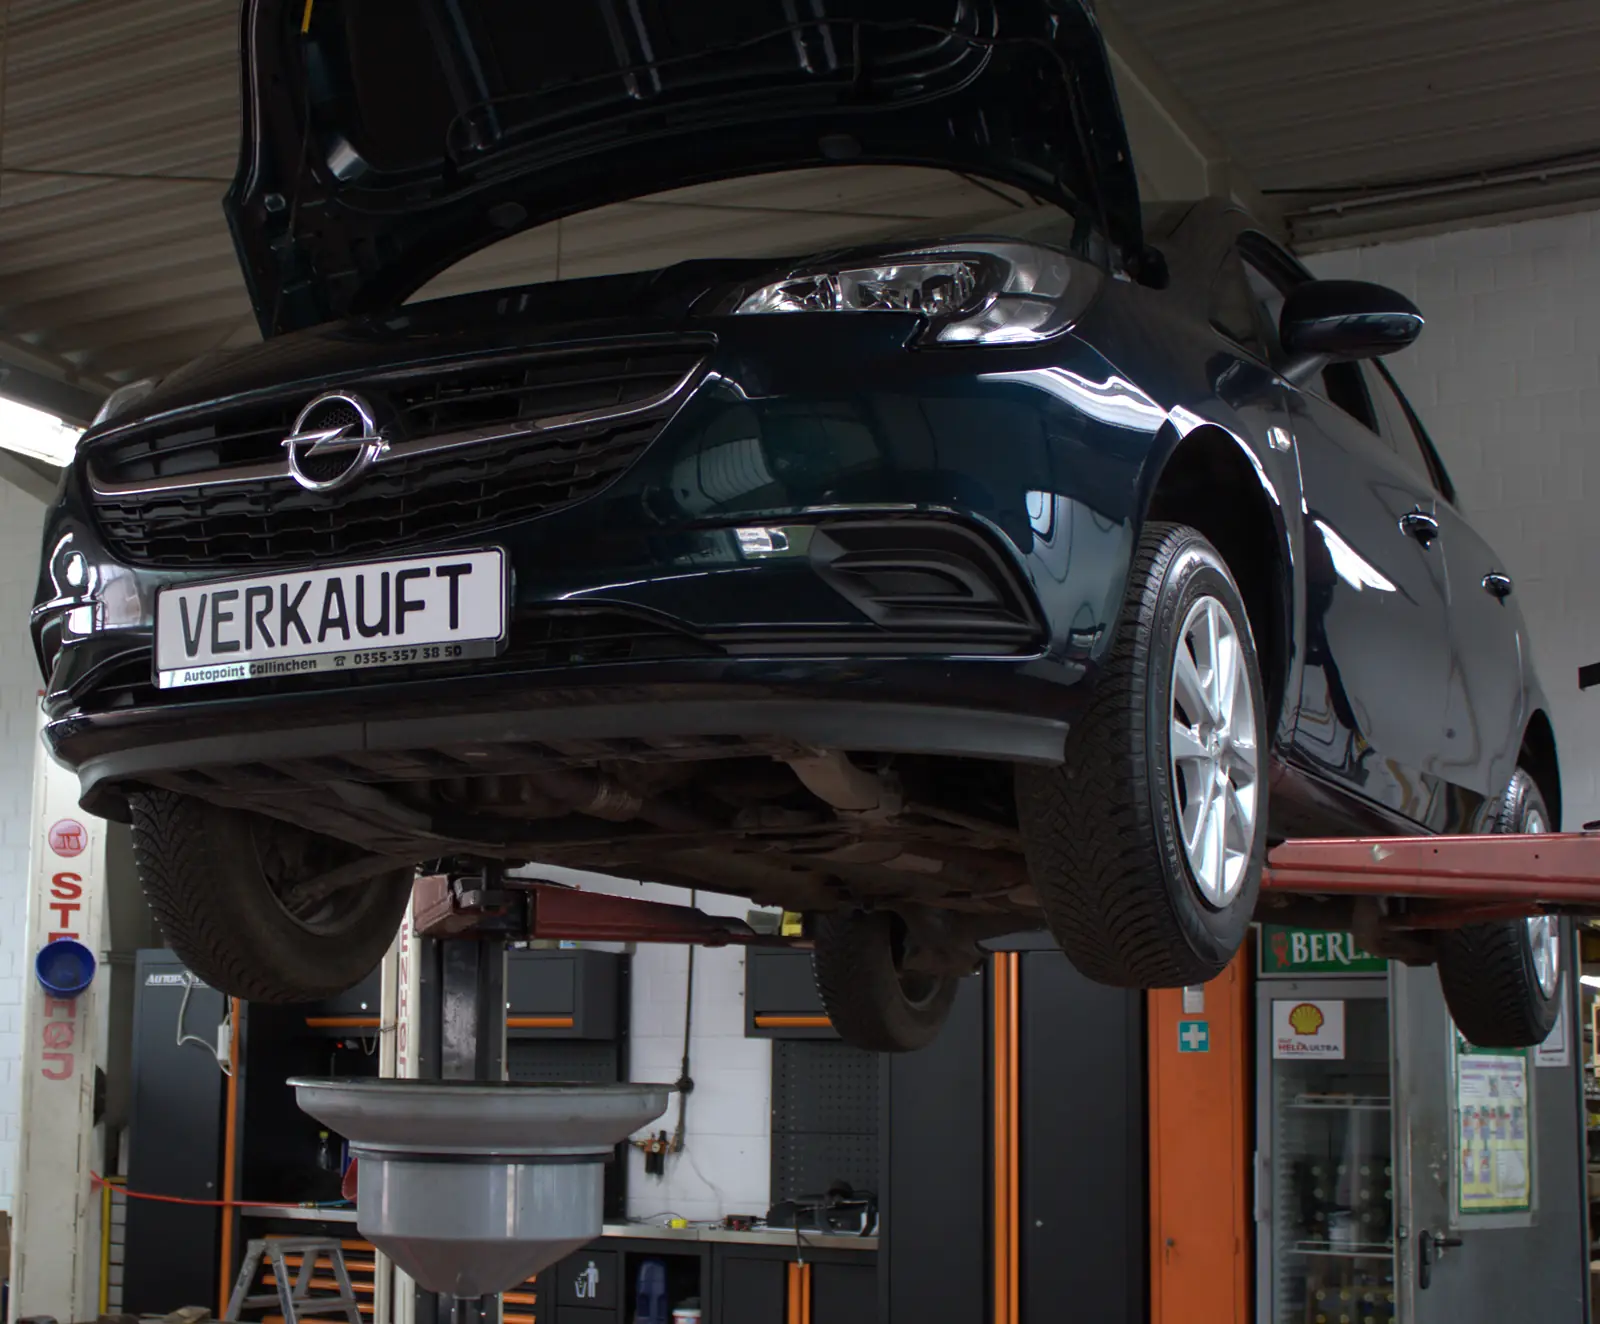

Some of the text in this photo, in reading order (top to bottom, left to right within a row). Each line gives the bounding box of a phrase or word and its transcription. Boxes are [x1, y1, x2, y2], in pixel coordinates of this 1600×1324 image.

[178, 562, 473, 658] VERKAUFT
[183, 644, 463, 683] Autopoint Gallinchen 0355-357 38 50
[1291, 931, 1376, 966] BERL
